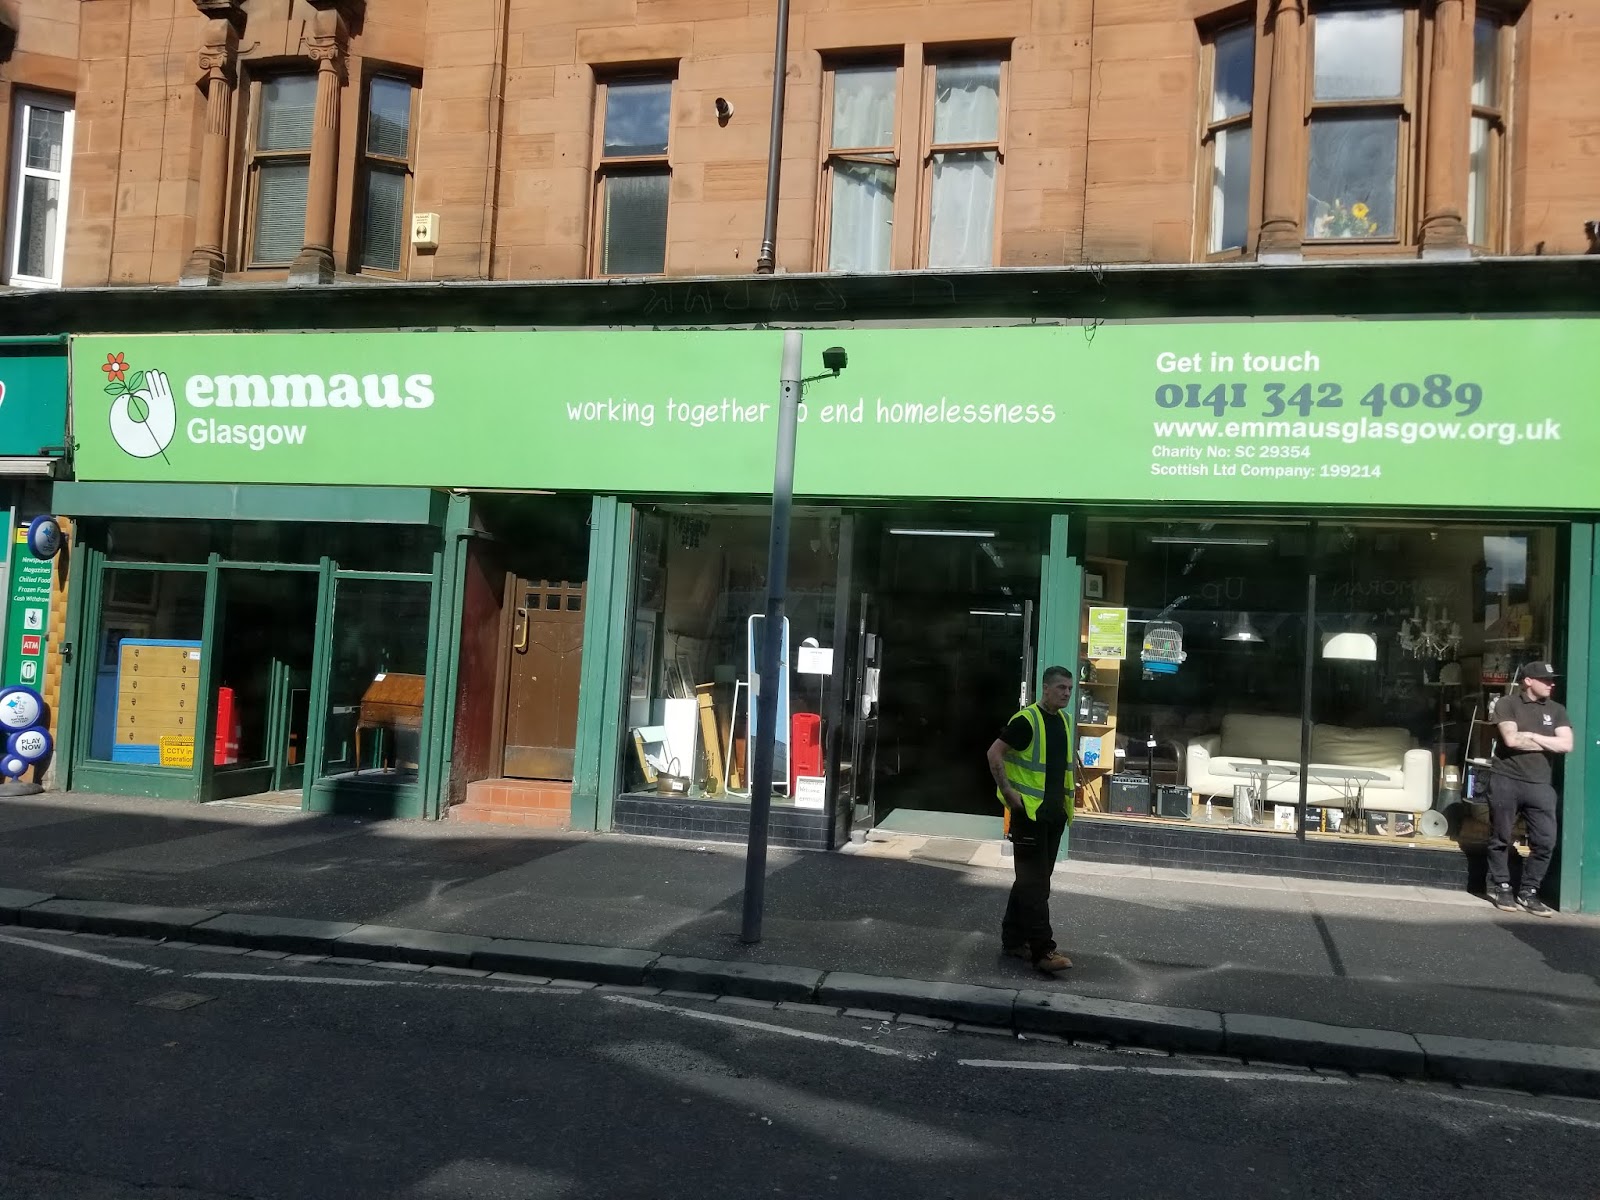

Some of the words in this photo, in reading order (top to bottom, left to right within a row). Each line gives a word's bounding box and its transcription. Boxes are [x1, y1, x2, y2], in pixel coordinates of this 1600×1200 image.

[1156, 352, 1203, 373] Get
[1210, 351, 1234, 372] in
[1243, 350, 1320, 372] touch
[185, 373, 435, 408] emmaus
[1155, 383, 1248, 417] 0141
[1262, 383, 1344, 417] 342
[1360, 374, 1483, 417] 4089
[566, 398, 655, 427] working
[666, 398, 771, 427] together
[820, 398, 864, 423] end
[876, 397, 1056, 423] homelessness
[187, 417, 307, 450] Glasgow
[1153, 417, 1561, 445] www.emmausglasgow.org.uk
[1152, 445, 1202, 460] Charity
[1207, 445, 1231, 458] No:
[1234, 446, 1256, 459] SC
[1259, 446, 1311, 459] 29354
[1151, 463, 1209, 477] Scottish
[1213, 463, 1236, 477] Ltd
[1241, 464, 1315, 480] Company:
[1320, 464, 1382, 479] 199214
[23, 640, 39, 649] ATM
